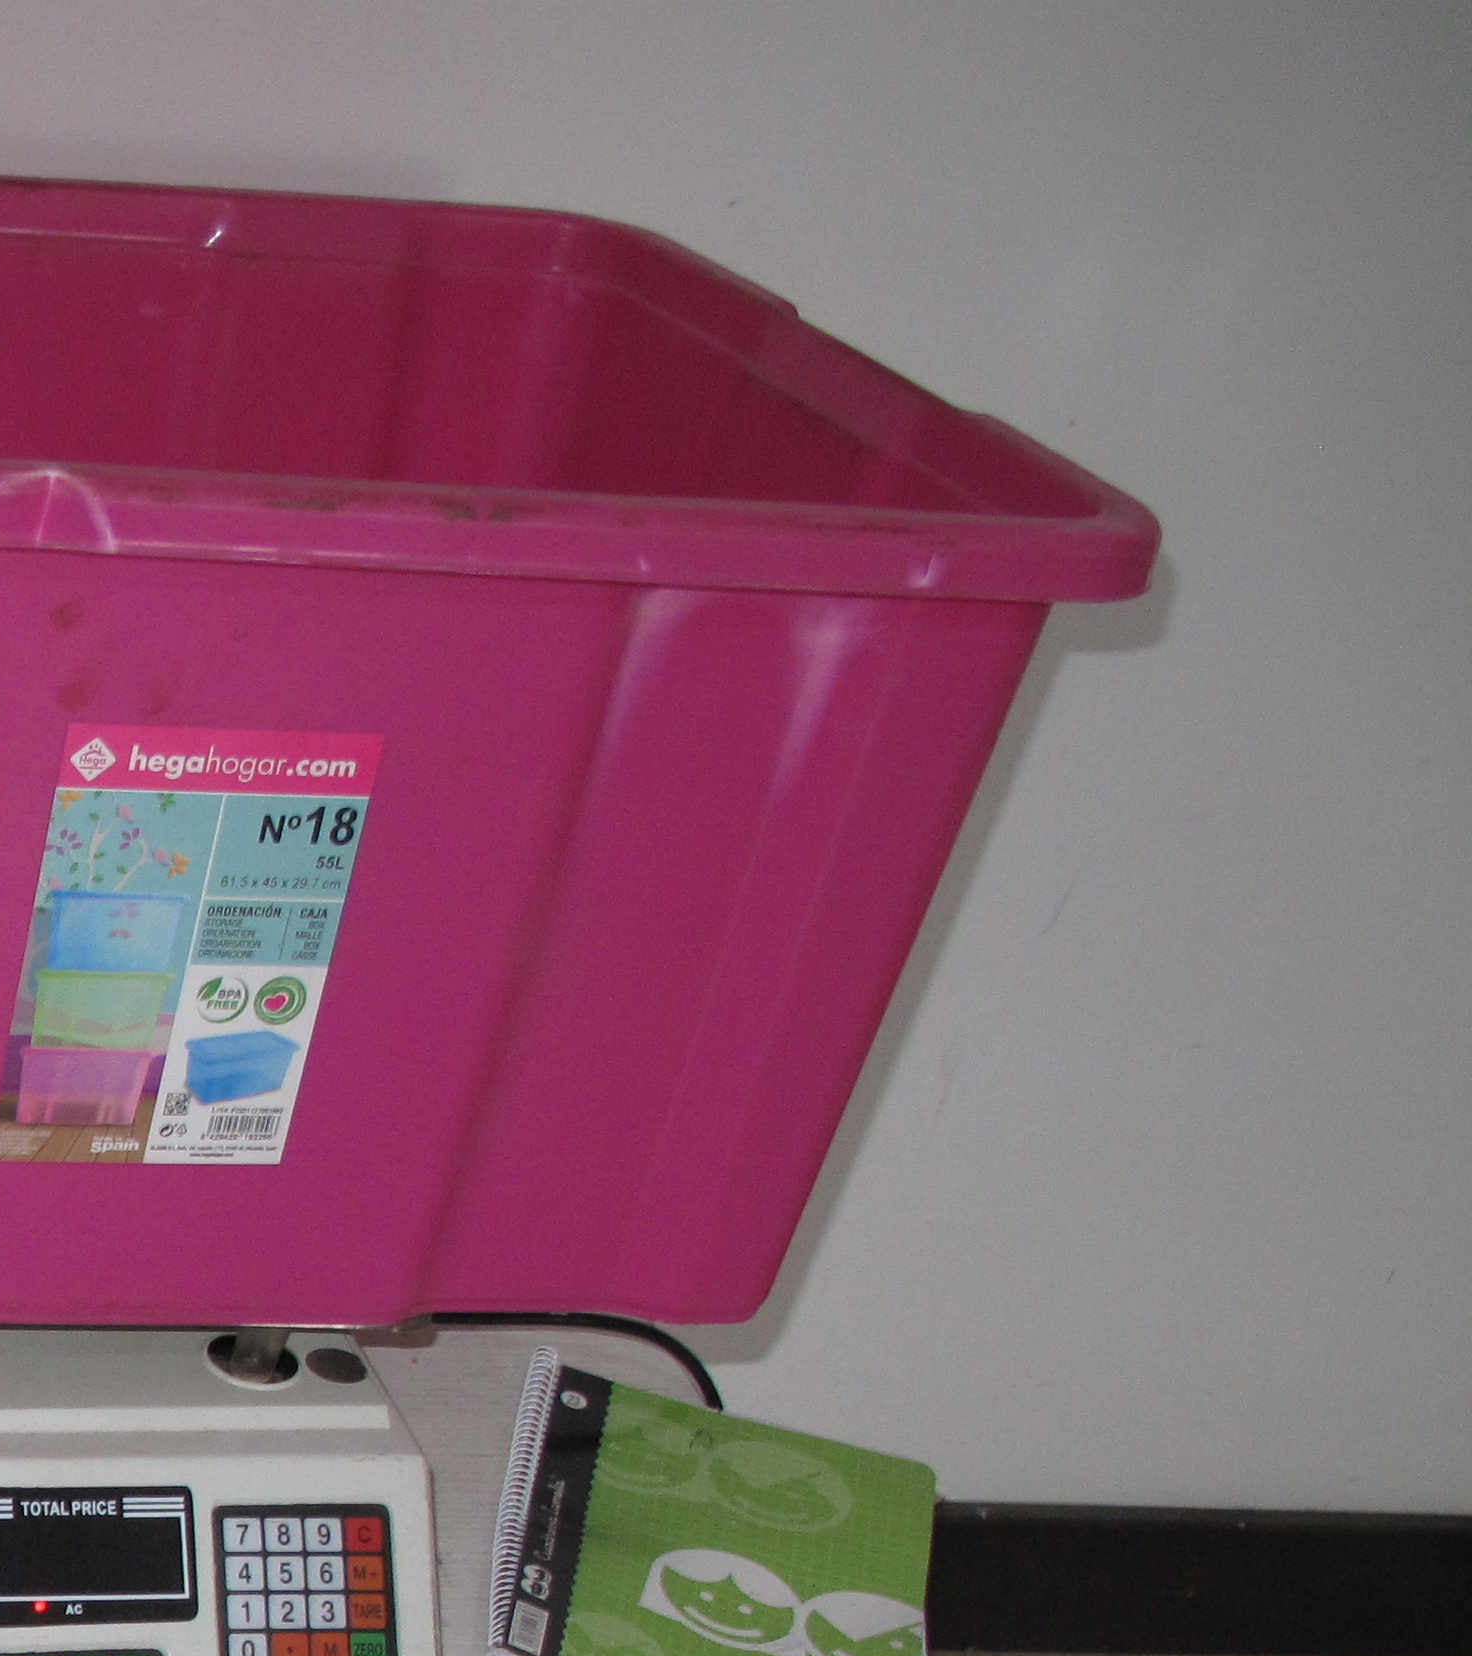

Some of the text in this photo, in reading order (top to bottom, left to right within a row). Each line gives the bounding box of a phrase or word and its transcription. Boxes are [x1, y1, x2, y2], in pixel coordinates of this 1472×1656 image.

[128, 744, 357, 783] hegahogar.com
[315, 856, 345, 870] 55L
[321, 879, 342, 889] cm
[207, 905, 328, 919] ORDENACIÓN CAJA
[206, 1000, 239, 1010] FREE
[90, 1138, 140, 1153] spain
[20, 1500, 117, 1518] TOTAL PRICE
[235, 1524, 250, 1545] 7
[277, 1524, 291, 1544] 8
[317, 1524, 332, 1544] 9
[237, 1564, 252, 1584] 4
[279, 1563, 293, 1583] 5
[319, 1563, 334, 1583] 6
[64, 1603, 84, 1616] AC
[241, 1602, 251, 1623] 1
[281, 1601, 295, 1622] 2
[321, 1601, 335, 1622] 3
[352, 1603, 382, 1619] TARE
